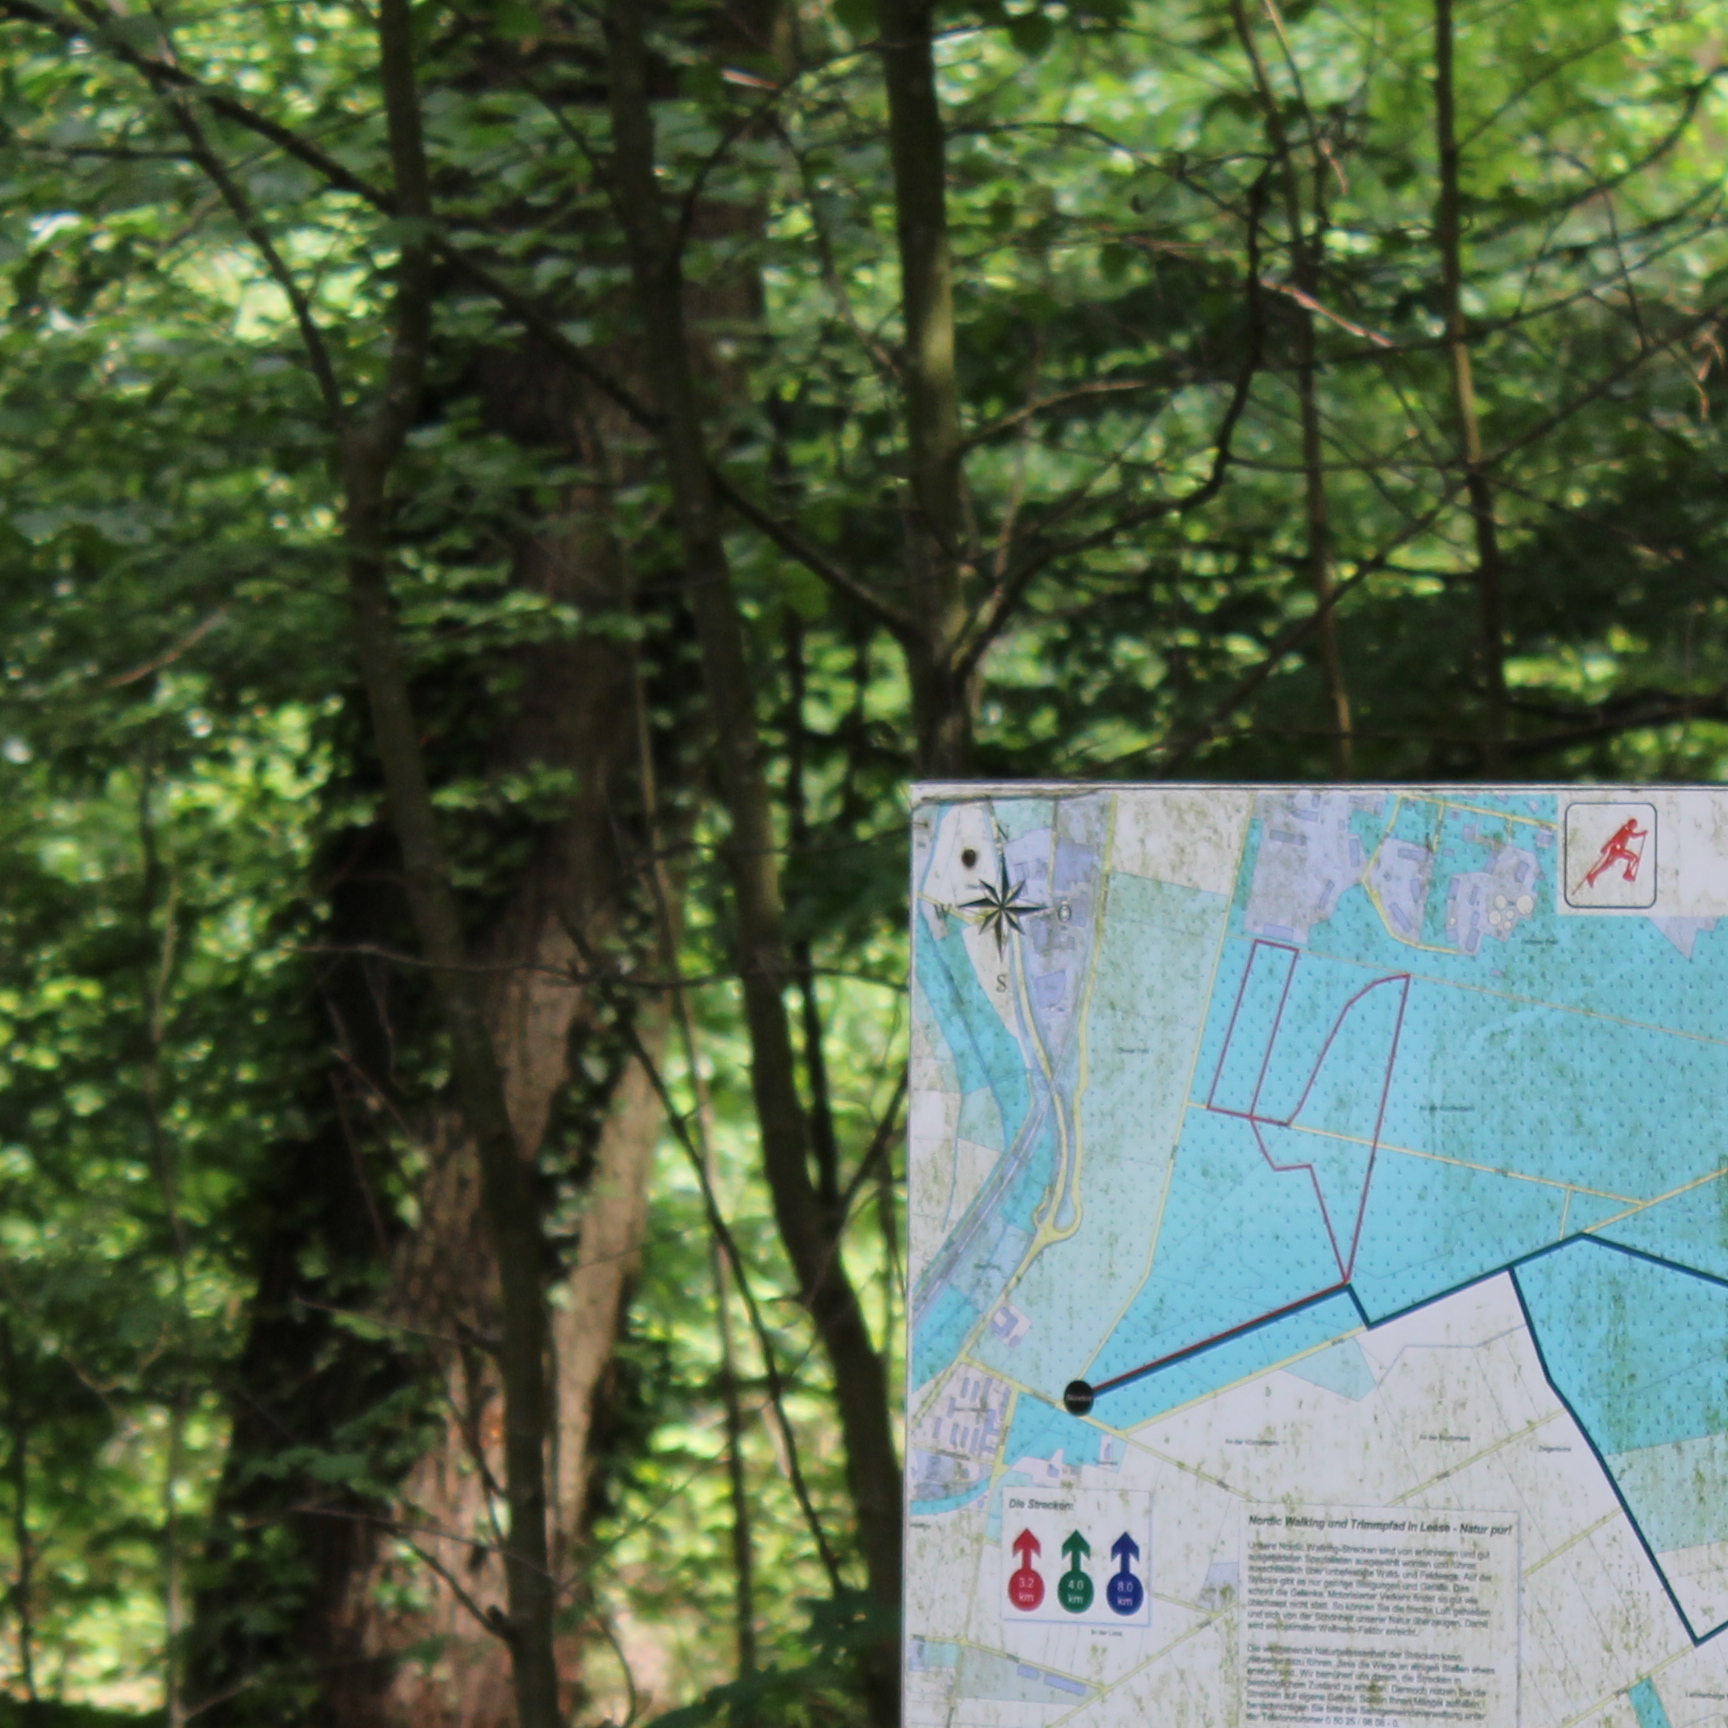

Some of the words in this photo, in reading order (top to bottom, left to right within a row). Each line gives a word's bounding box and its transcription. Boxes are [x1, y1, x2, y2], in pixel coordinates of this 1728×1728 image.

[996, 974, 1007, 992] S
[1008, 1498, 1025, 1509] Die
[1459, 1523, 1488, 1534] Natur
[1018, 1577, 1034, 1588] 3.2
[1067, 1579, 1084, 1590] 4.0
[1117, 1582, 1134, 1593] 8.0
[1018, 1592, 1034, 1602] km
[1067, 1594, 1083, 1604] km
[1117, 1597, 1133, 1606] km
